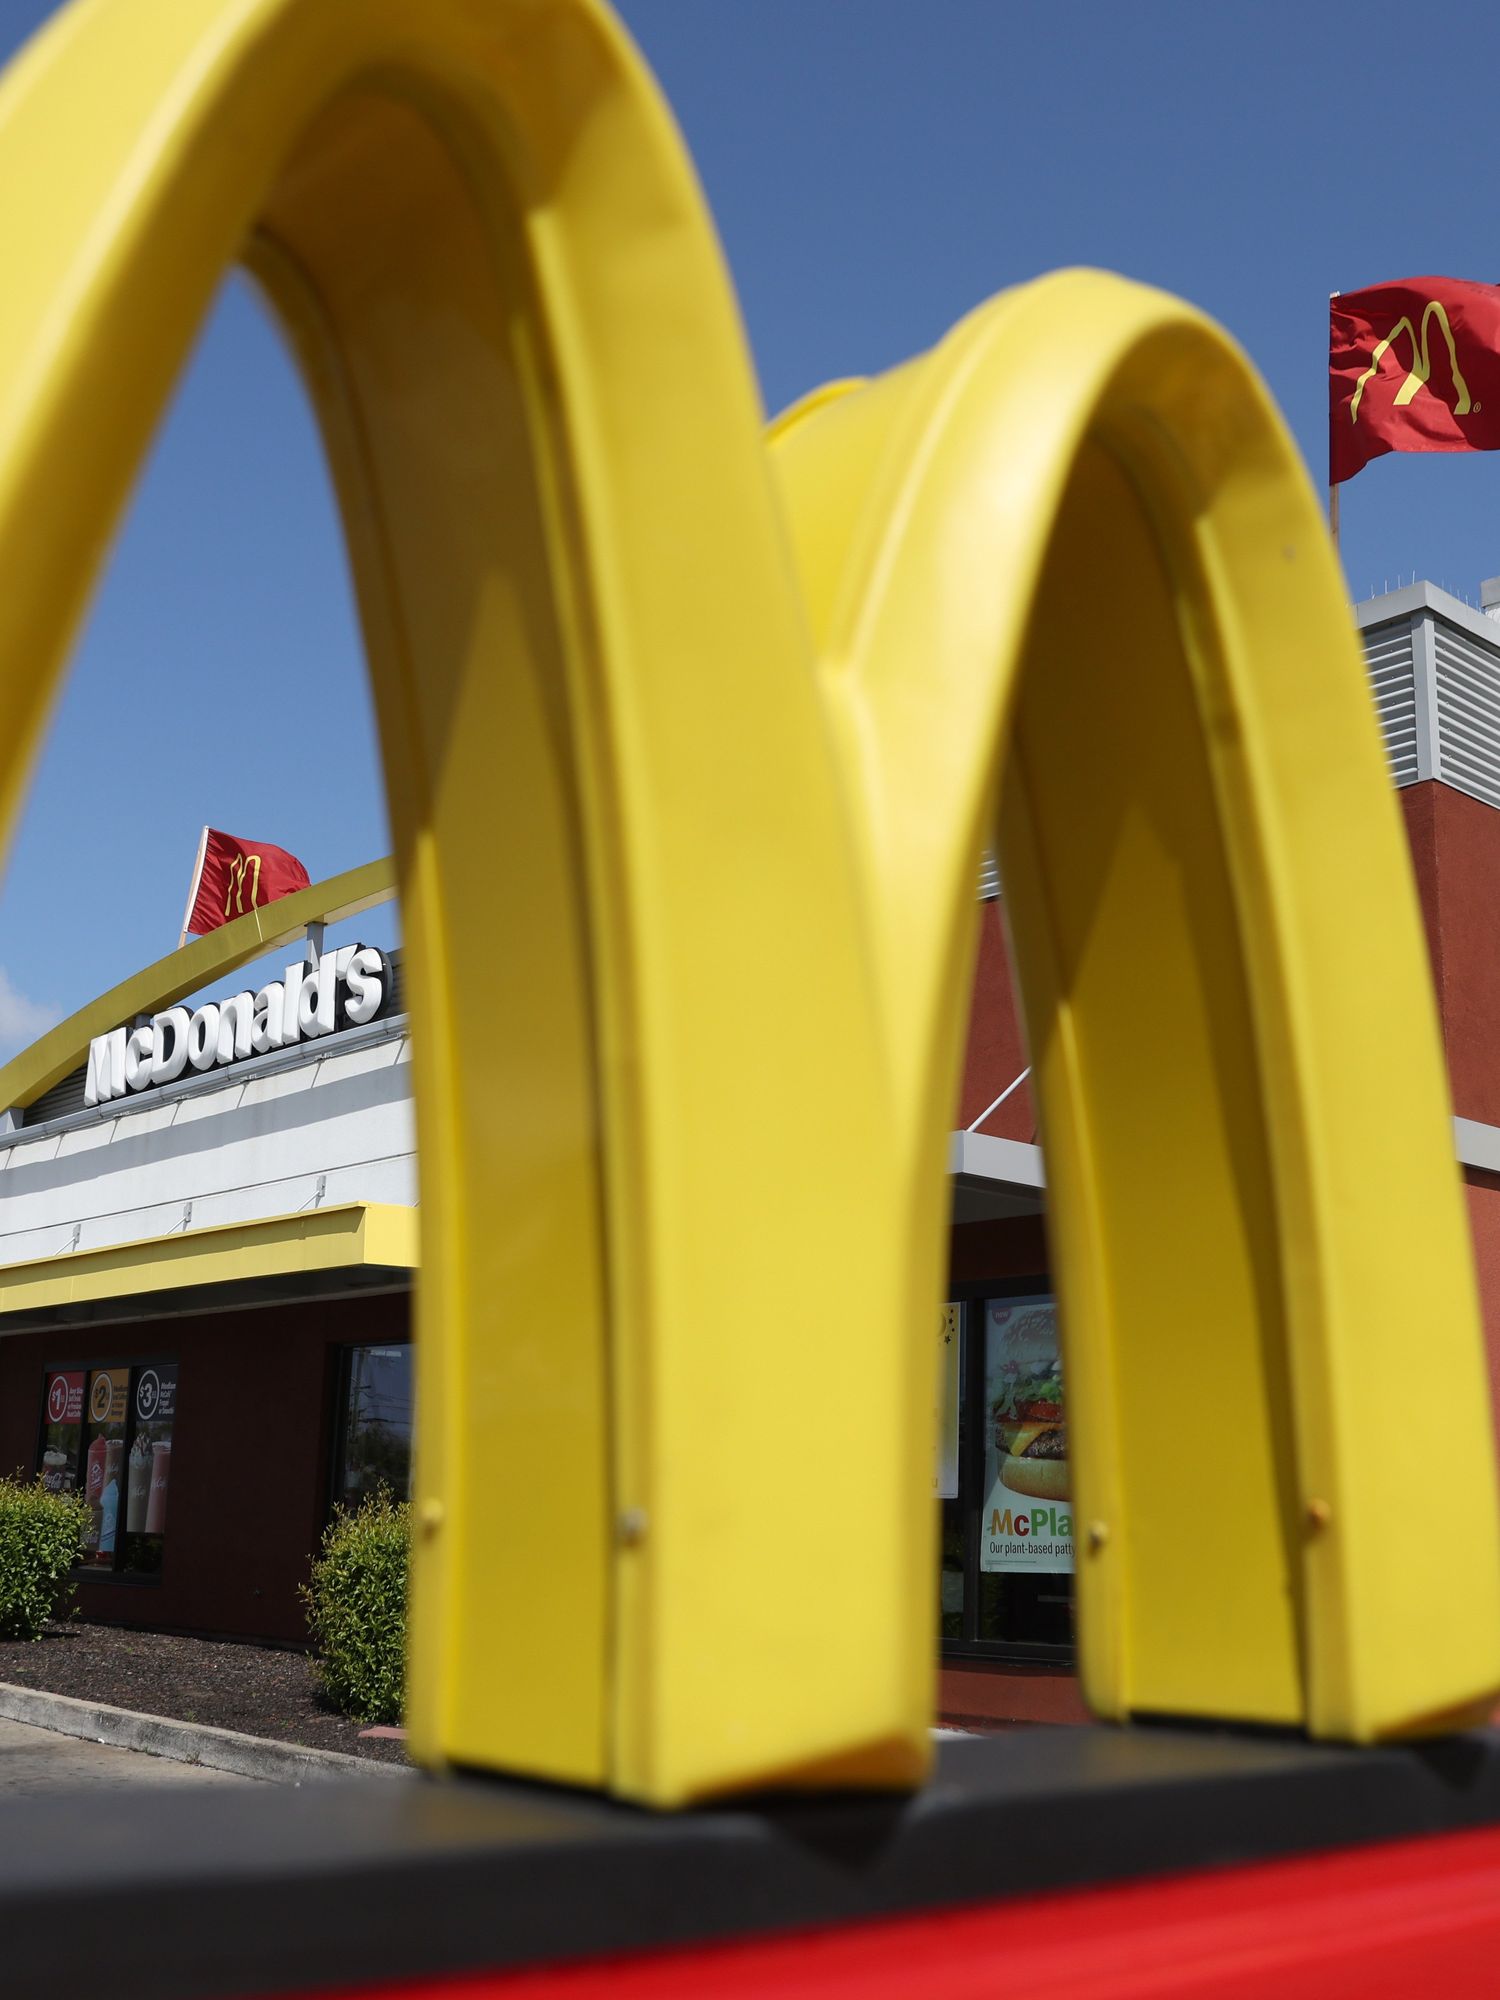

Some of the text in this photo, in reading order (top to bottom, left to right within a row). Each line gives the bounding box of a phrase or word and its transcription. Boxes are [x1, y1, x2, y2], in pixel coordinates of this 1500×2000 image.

[84, 943, 385, 1106] McDonald's
[990, 1542, 1004, 1554] Our
[1005, 1542, 1053, 1556] plant-based
